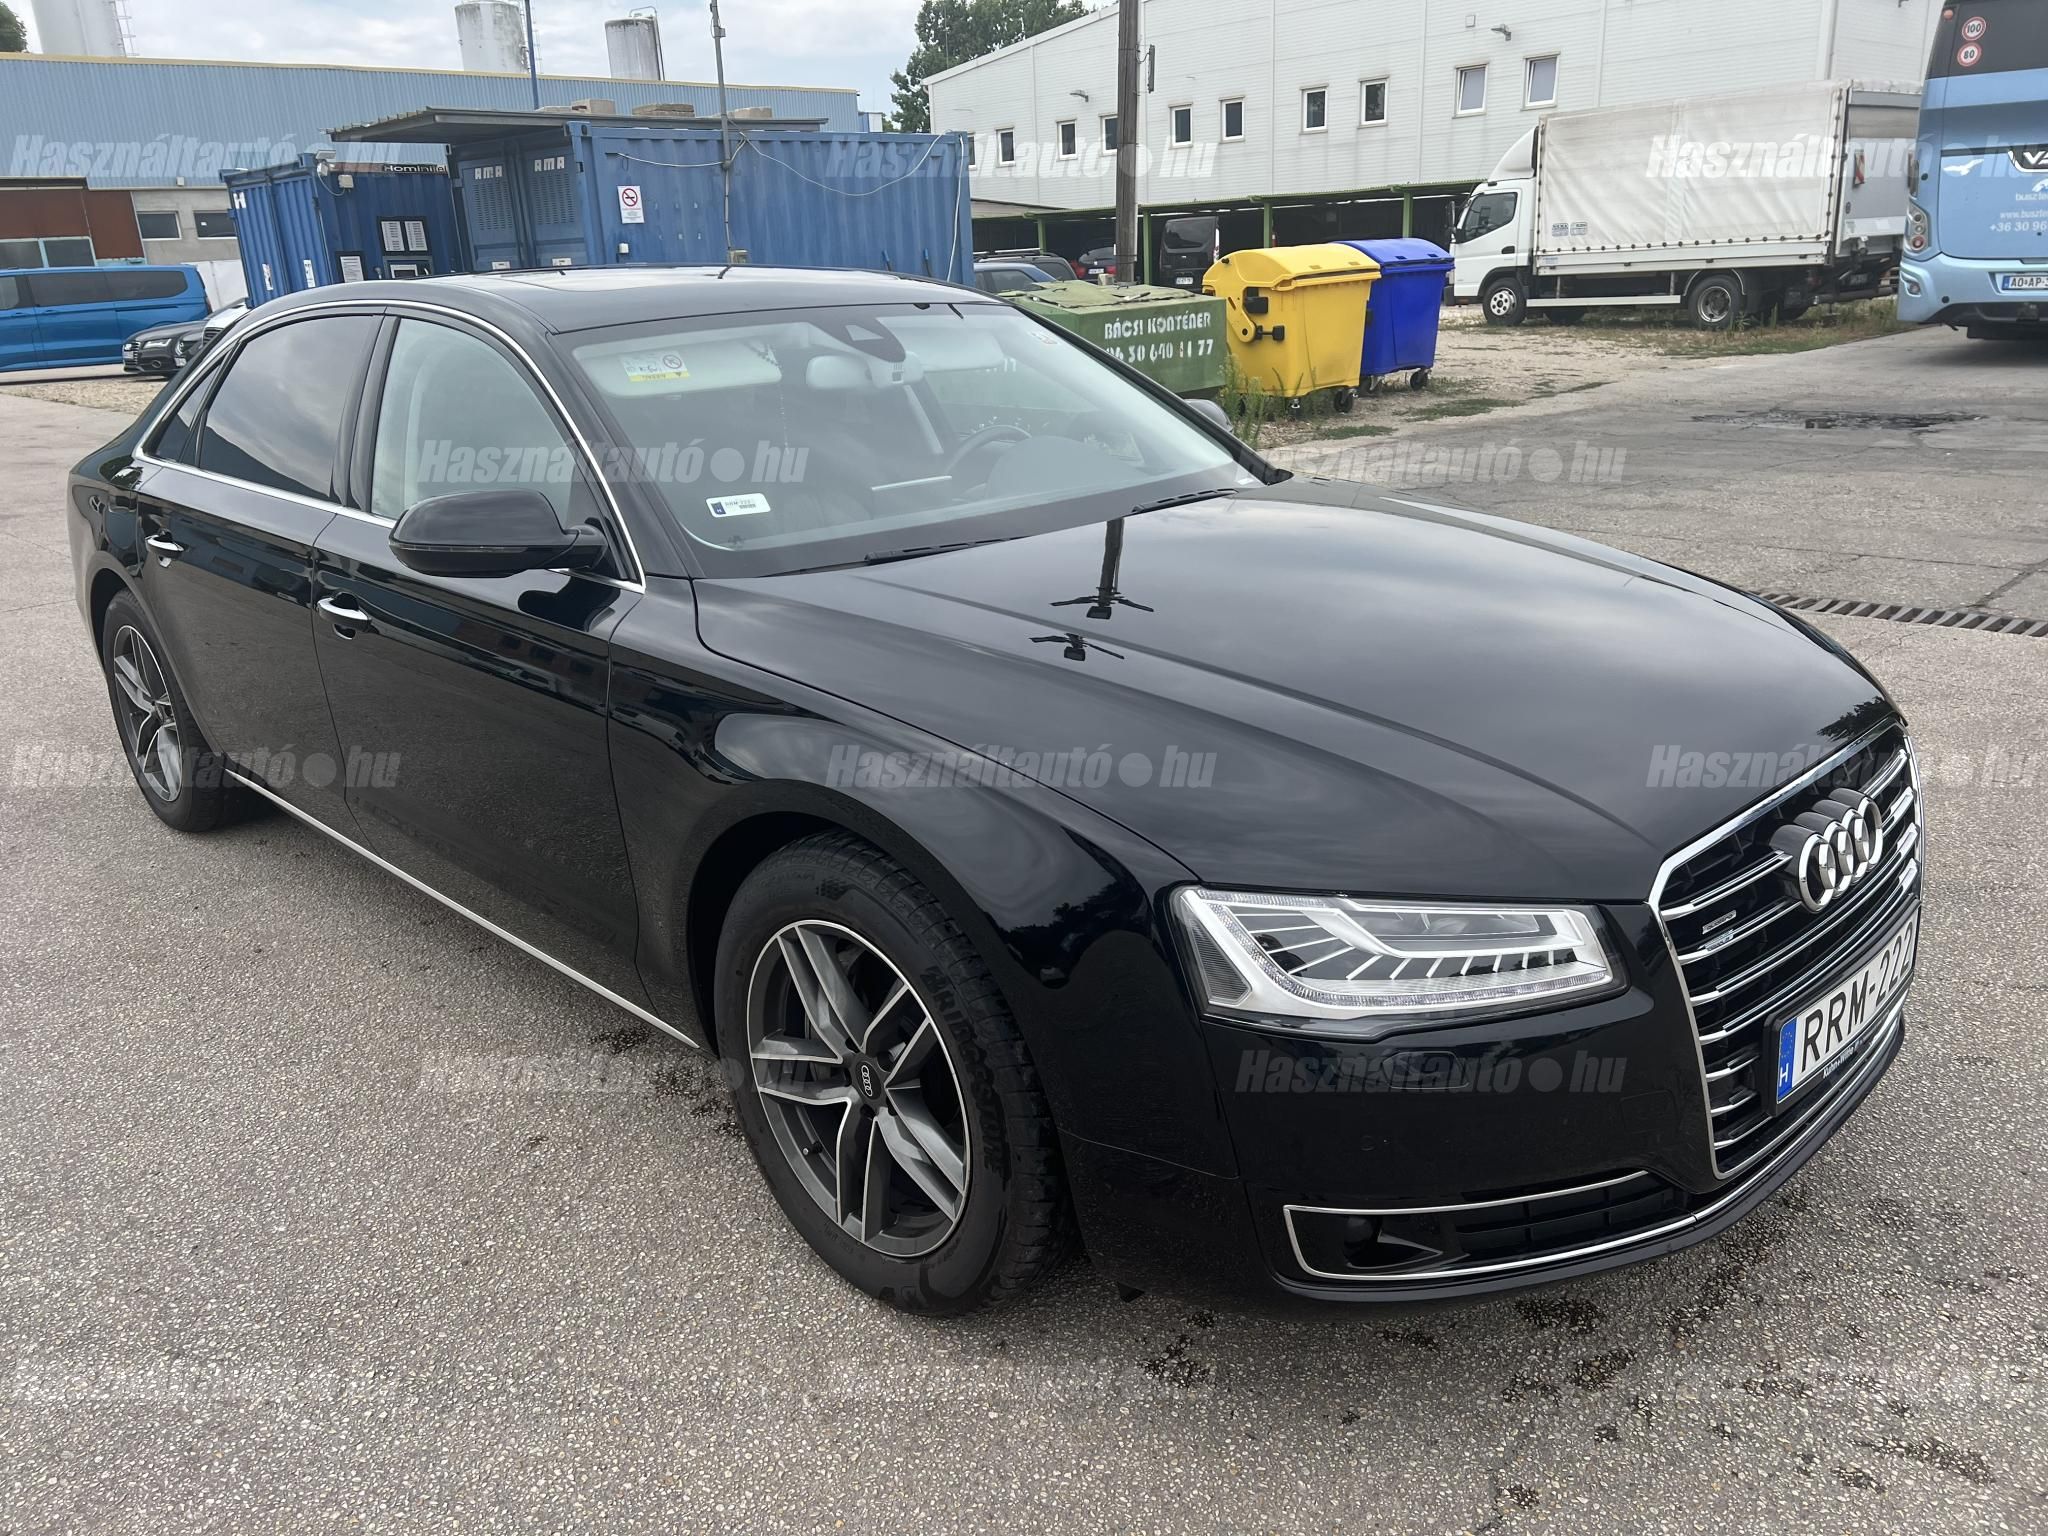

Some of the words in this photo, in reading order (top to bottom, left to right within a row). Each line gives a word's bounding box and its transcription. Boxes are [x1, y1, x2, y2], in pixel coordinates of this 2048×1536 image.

[1967, 23, 1981, 33] 100
[1963, 49, 1975, 59] 80
[1990, 222, 2011, 232] +36
[2014, 222, 2029, 231] 30
[1104, 317, 1143, 340] BÁCSI
[1147, 310, 1211, 335] KONTÉNER
[1197, 338, 1214, 356] 77
[1800, 922, 1914, 1073] RRM-222
[1778, 1063, 1790, 1088] H
